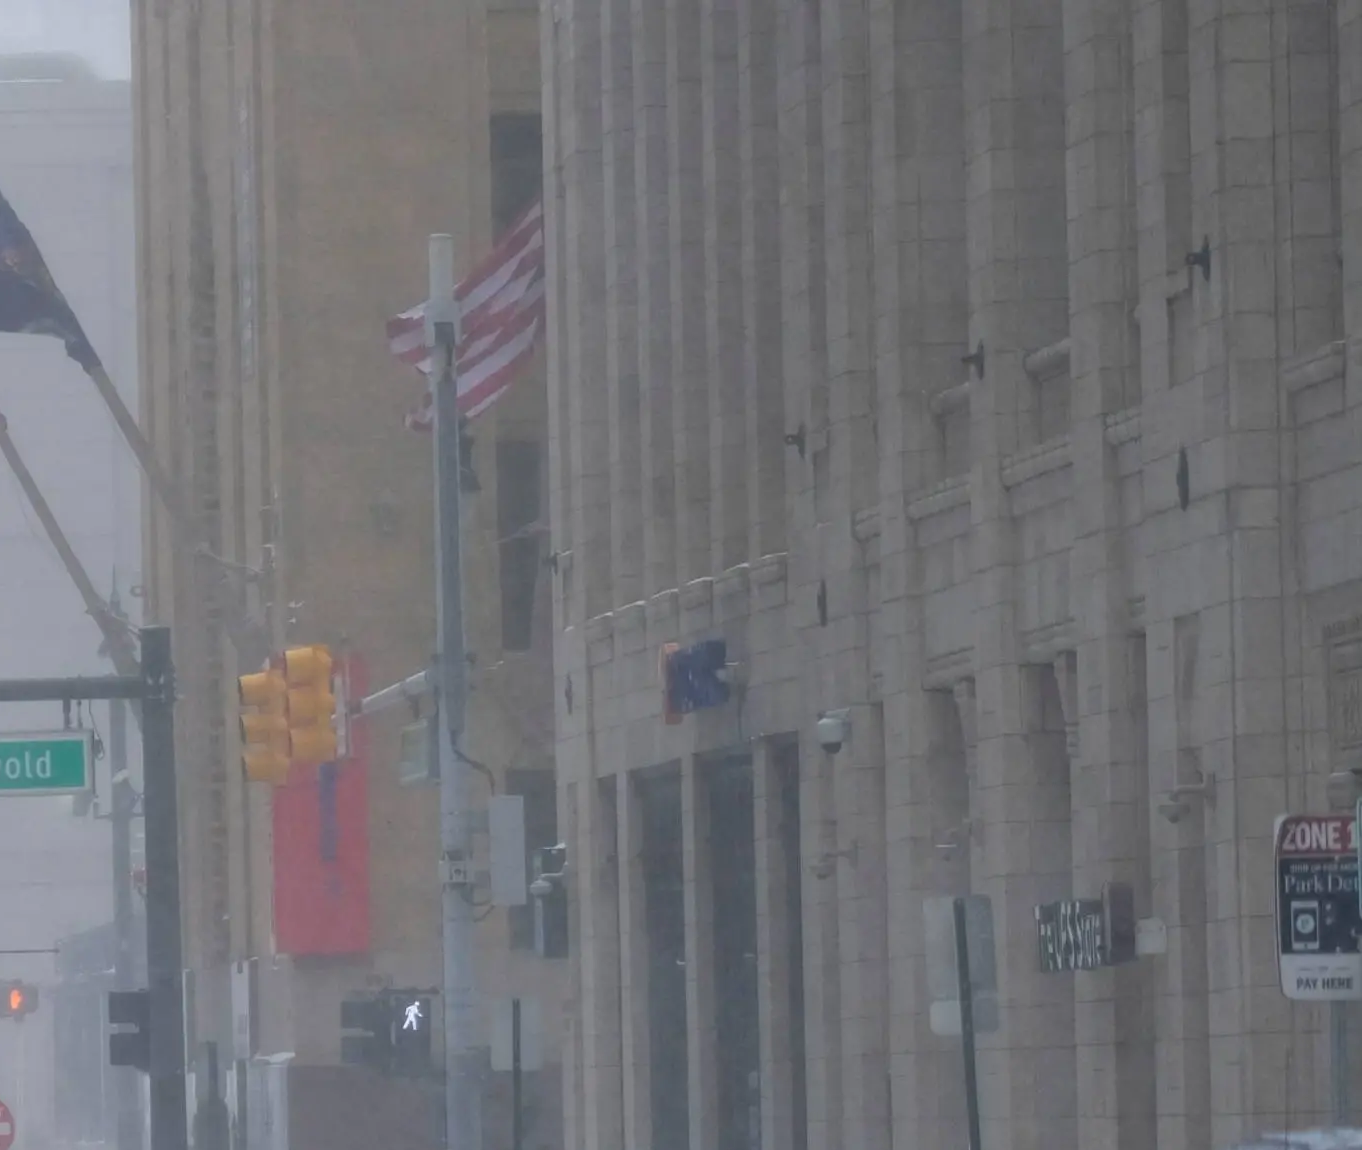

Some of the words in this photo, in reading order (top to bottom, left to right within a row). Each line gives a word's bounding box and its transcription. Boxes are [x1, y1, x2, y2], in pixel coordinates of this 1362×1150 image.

[1282, 820, 1342, 851] ZONE
[1296, 976, 1318, 991] PAY
[1321, 976, 1354, 991] HERE
